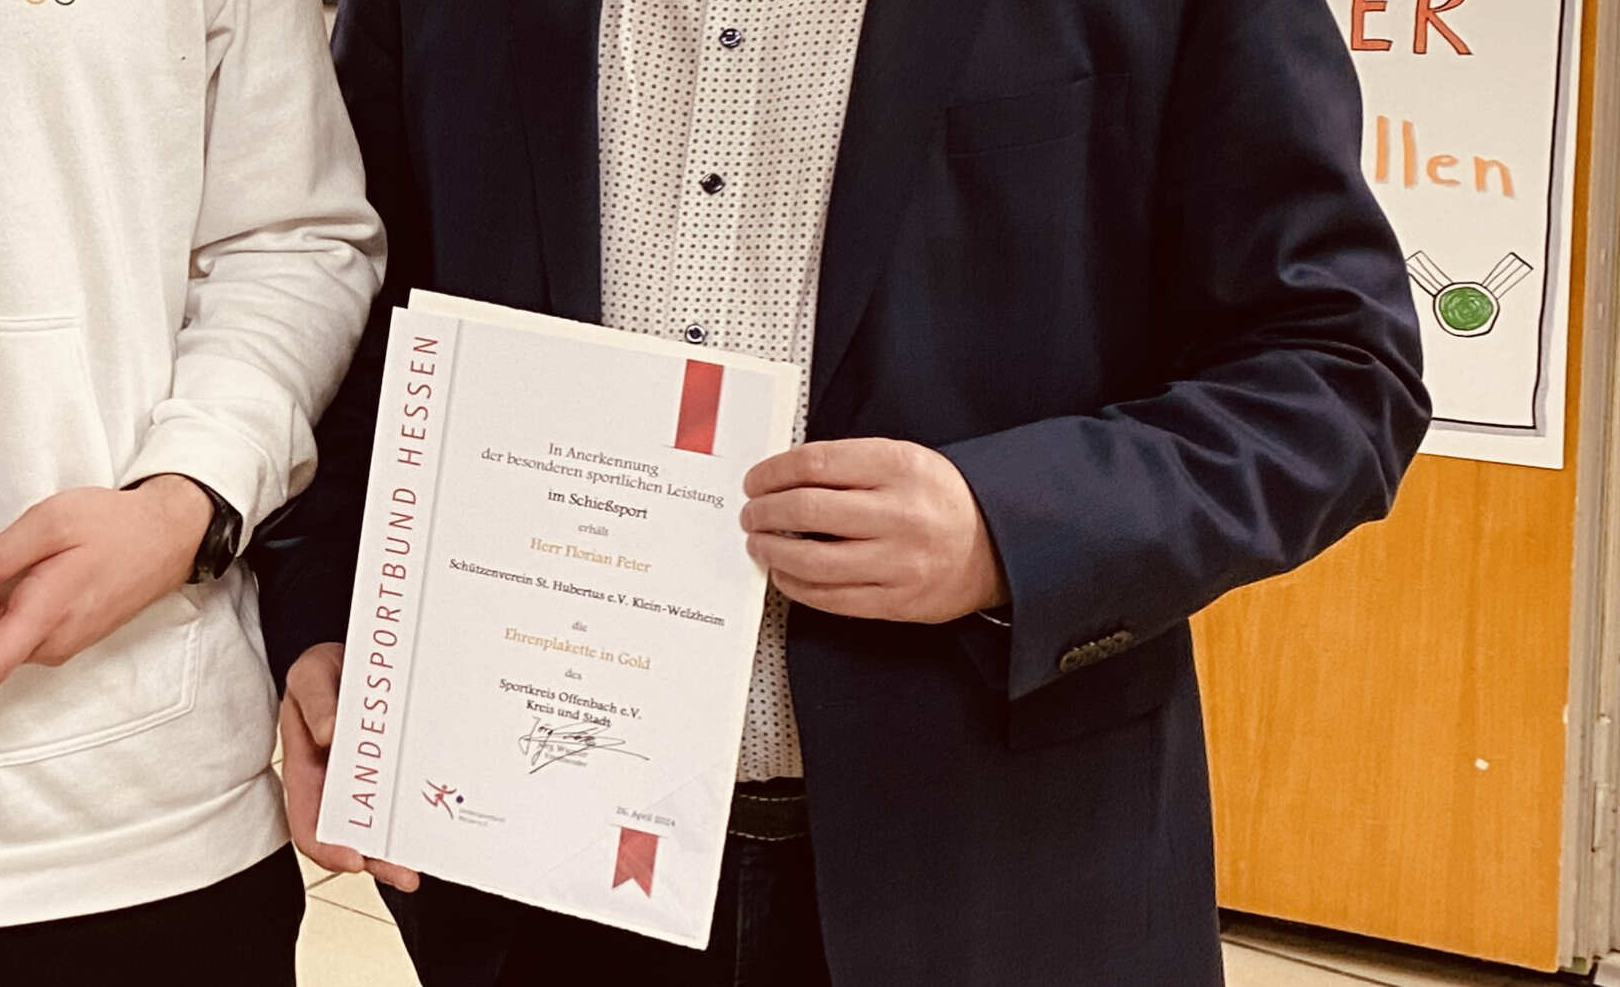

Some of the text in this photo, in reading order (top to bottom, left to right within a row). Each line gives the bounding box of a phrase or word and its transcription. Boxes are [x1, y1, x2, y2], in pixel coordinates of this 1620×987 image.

[1375, 114, 1515, 198] llen
[481, 447, 724, 509] der besonderen sportlichen Leistung
[548, 442, 660, 477] In Anerkennung
[547, 487, 648, 519] im Schießsport
[578, 523, 609, 537] erhält
[530, 537, 652, 573] Herr Florian Peter
[348, 336, 439, 829] LANDESSPORTBUND HESSEN
[449, 558, 725, 627] Schützenverein St. Hubertus e.V. Klein-Welzheim
[504, 627, 652, 670] Ehrenplakette in Gold
[499, 678, 643, 720] Sportkreis Offenbach e.V.
[526, 699, 612, 728] Kreis und Stadt
